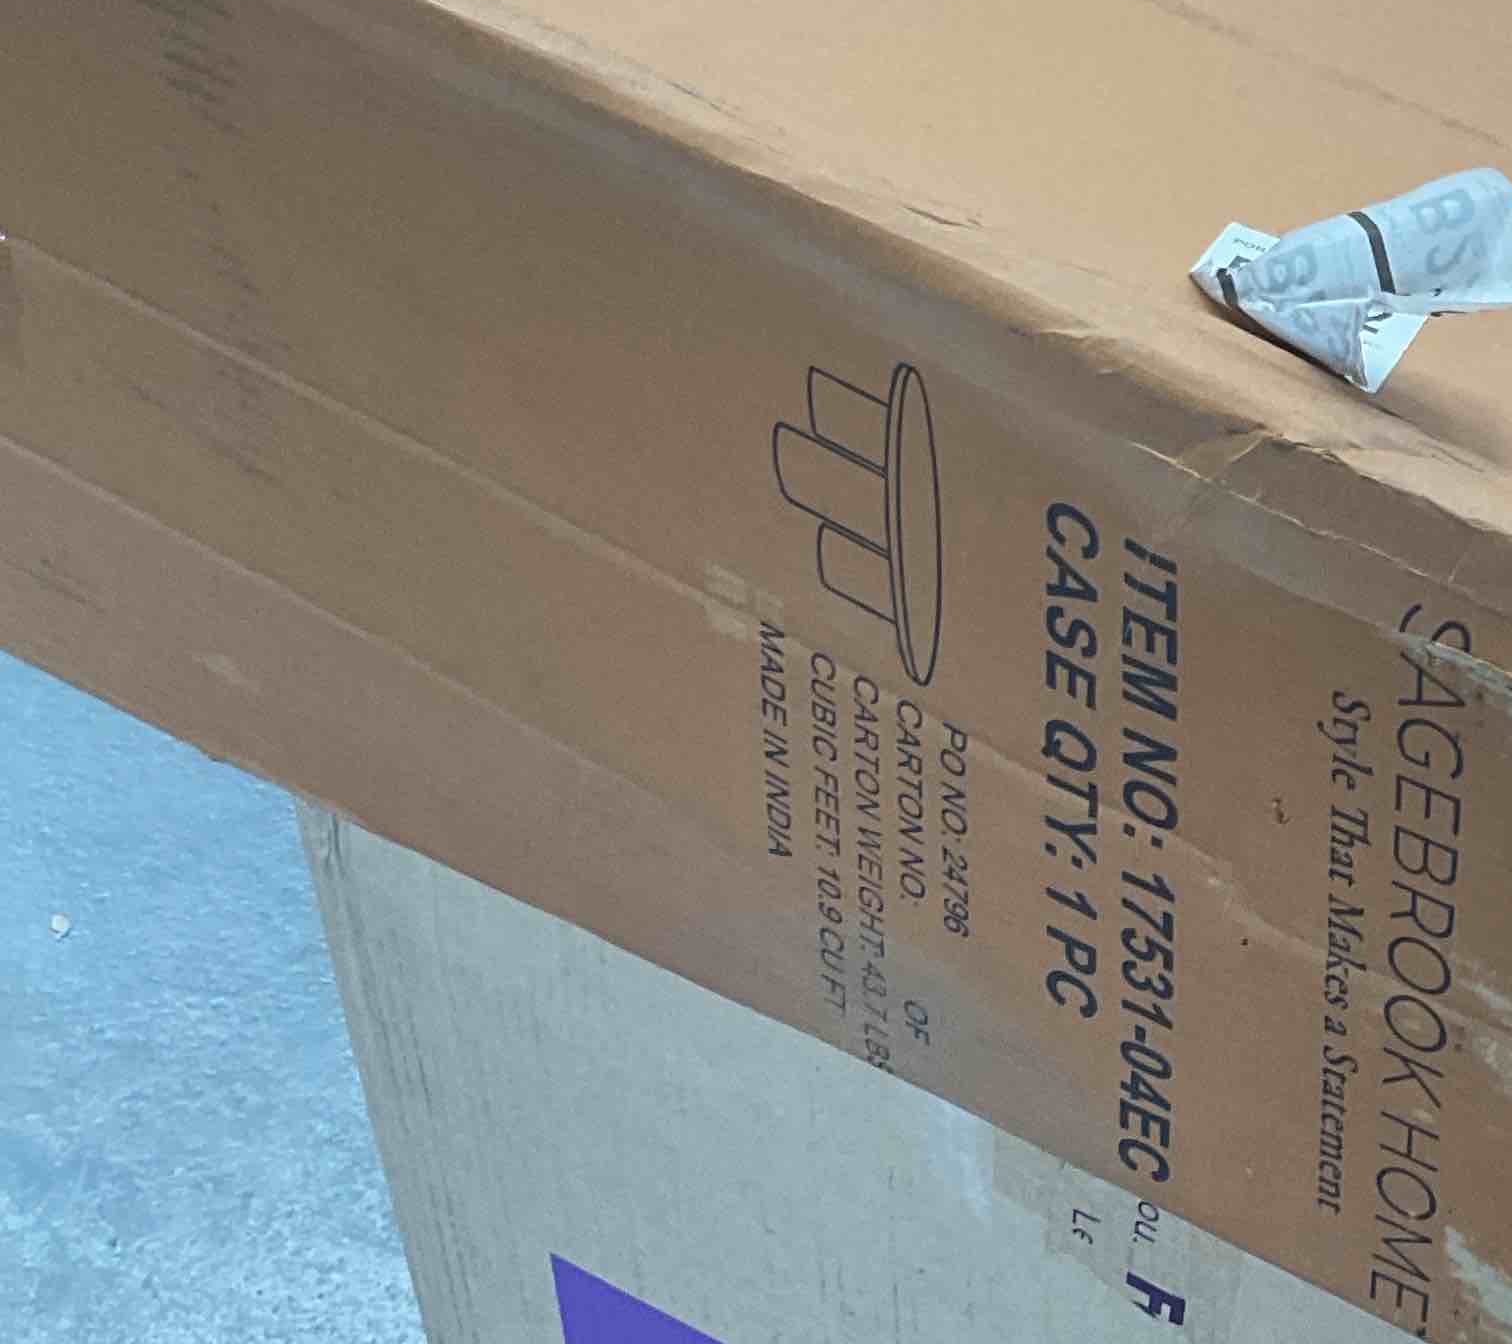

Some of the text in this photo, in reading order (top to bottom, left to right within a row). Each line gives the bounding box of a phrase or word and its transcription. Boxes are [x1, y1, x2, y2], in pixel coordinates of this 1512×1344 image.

[760, 620, 793, 857] MADE IN INDIA
[810, 651, 847, 1017] CUBIC FEET: 10.9 CU FT
[853, 674, 882, 822] CARTON
[856, 826, 885, 958] WEIGHT:
[896, 699, 931, 1046] CARTON NO: OF
[940, 720, 969, 938] PO NO: 24796
[1041, 502, 1099, 1019] CASE QTY: 1 PC
[1117, 537, 1178, 1183] ITEM NO: 17531-04EC
[1316, 690, 1375, 1216] Style That Makes a Statement
[1369, 604, 1471, 1324] SAGEBROOK HOME
